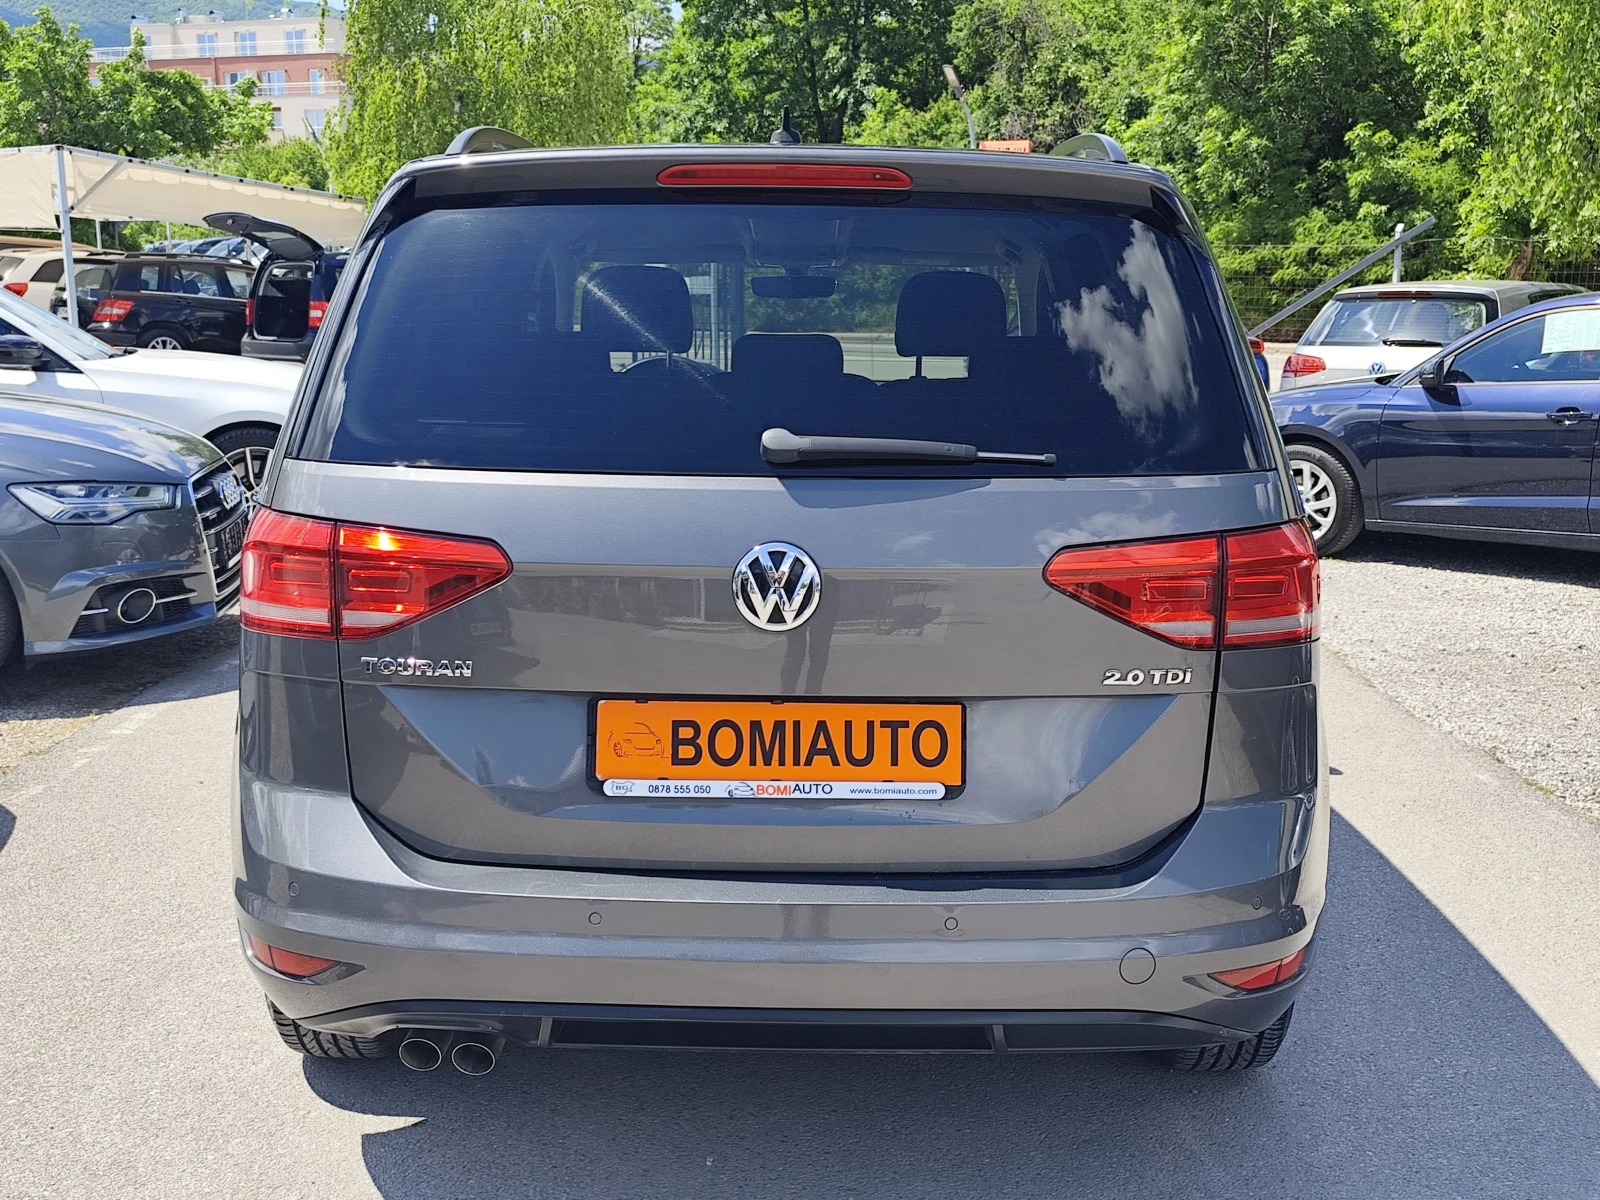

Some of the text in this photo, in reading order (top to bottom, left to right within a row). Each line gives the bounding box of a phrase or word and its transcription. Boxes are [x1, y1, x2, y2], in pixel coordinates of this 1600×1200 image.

[733, 542, 820, 631] VW
[360, 656, 473, 677] TOURAN
[670, 719, 949, 768] BOMIAUTO
[648, 784, 671, 794] 0878
[674, 784, 691, 794] 555
[693, 784, 711, 794] 050
[756, 783, 833, 796] BOMIAUTO
[849, 786, 938, 795] www.bomiauto.com
